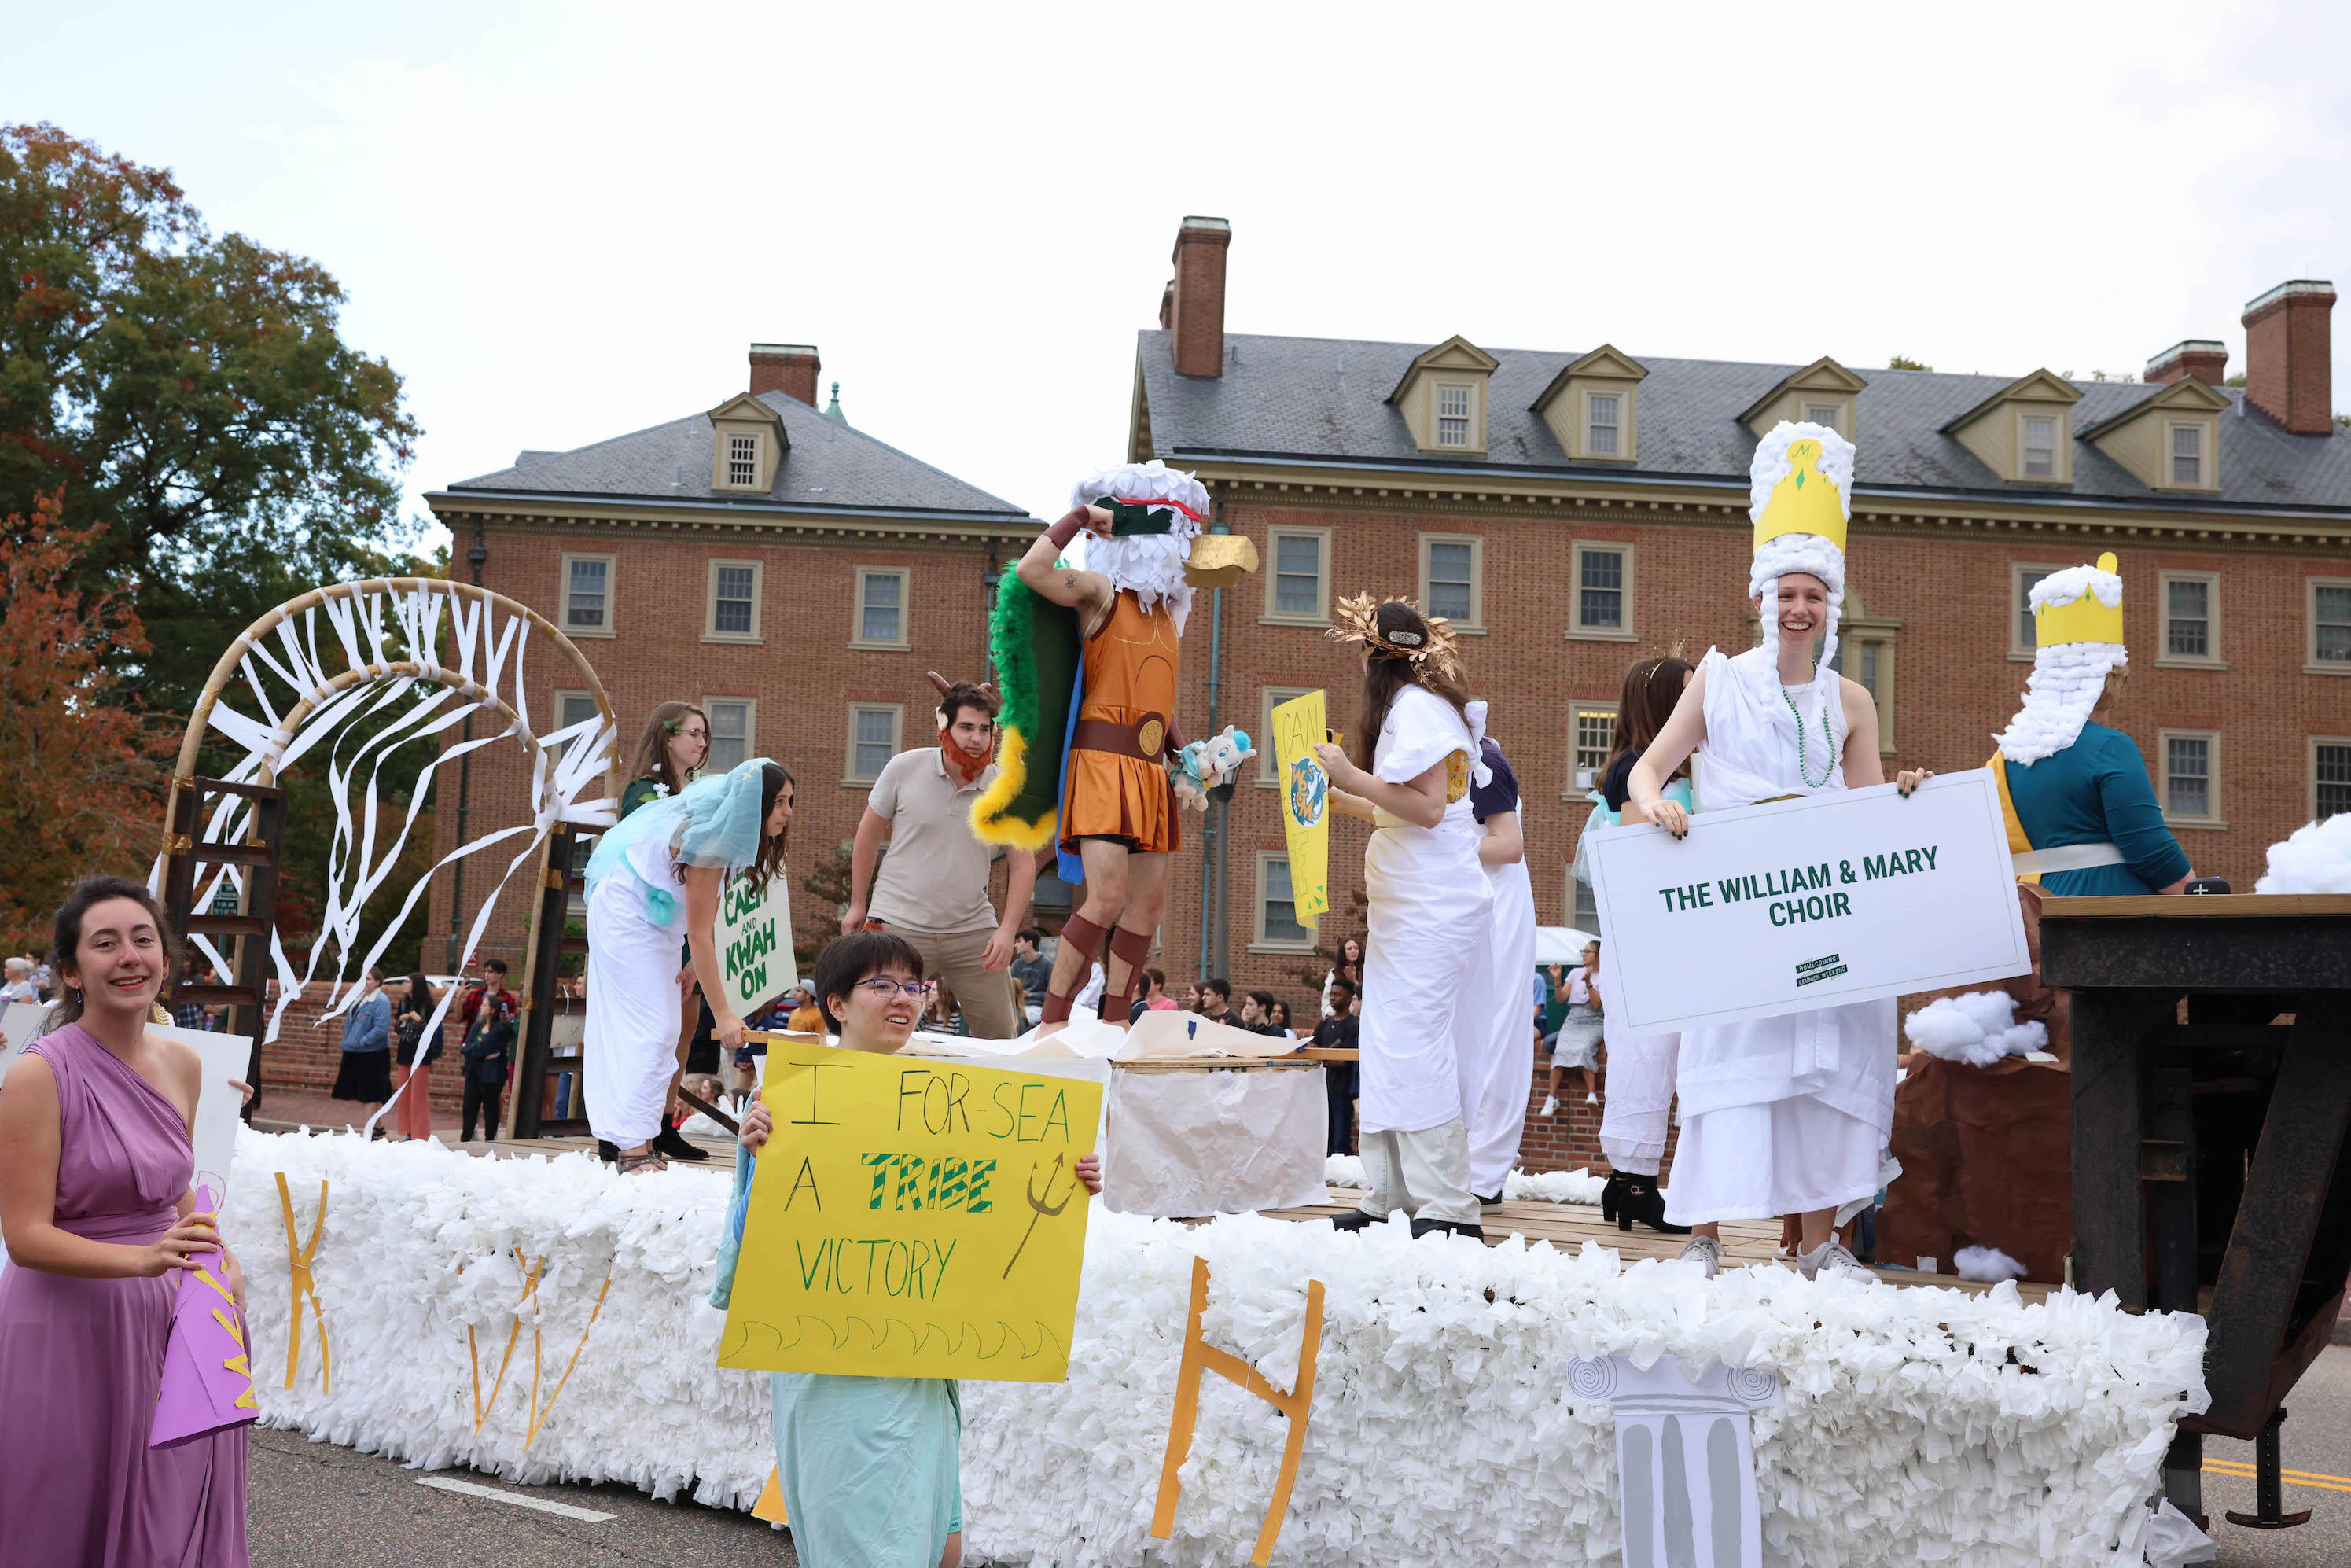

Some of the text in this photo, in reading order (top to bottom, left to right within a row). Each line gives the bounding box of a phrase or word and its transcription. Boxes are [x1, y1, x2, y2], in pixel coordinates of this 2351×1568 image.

[1282, 704, 1319, 758] CAN
[1658, 845, 1938, 913] THE WILLIAM & MARY
[741, 917, 757, 937] AND
[1768, 892, 1852, 927] CHOIR
[726, 918, 777, 981] KWAH
[1798, 955, 1837, 972] HOMECOMING
[1798, 974, 1820, 986] REUNION
[1821, 966, 1846, 978] WEEKEND
[741, 961, 767, 1000] ON
[789, 1062, 853, 1125] I
[784, 1152, 998, 1213] A TRIBE
[796, 1239, 957, 1302] VICTORY
